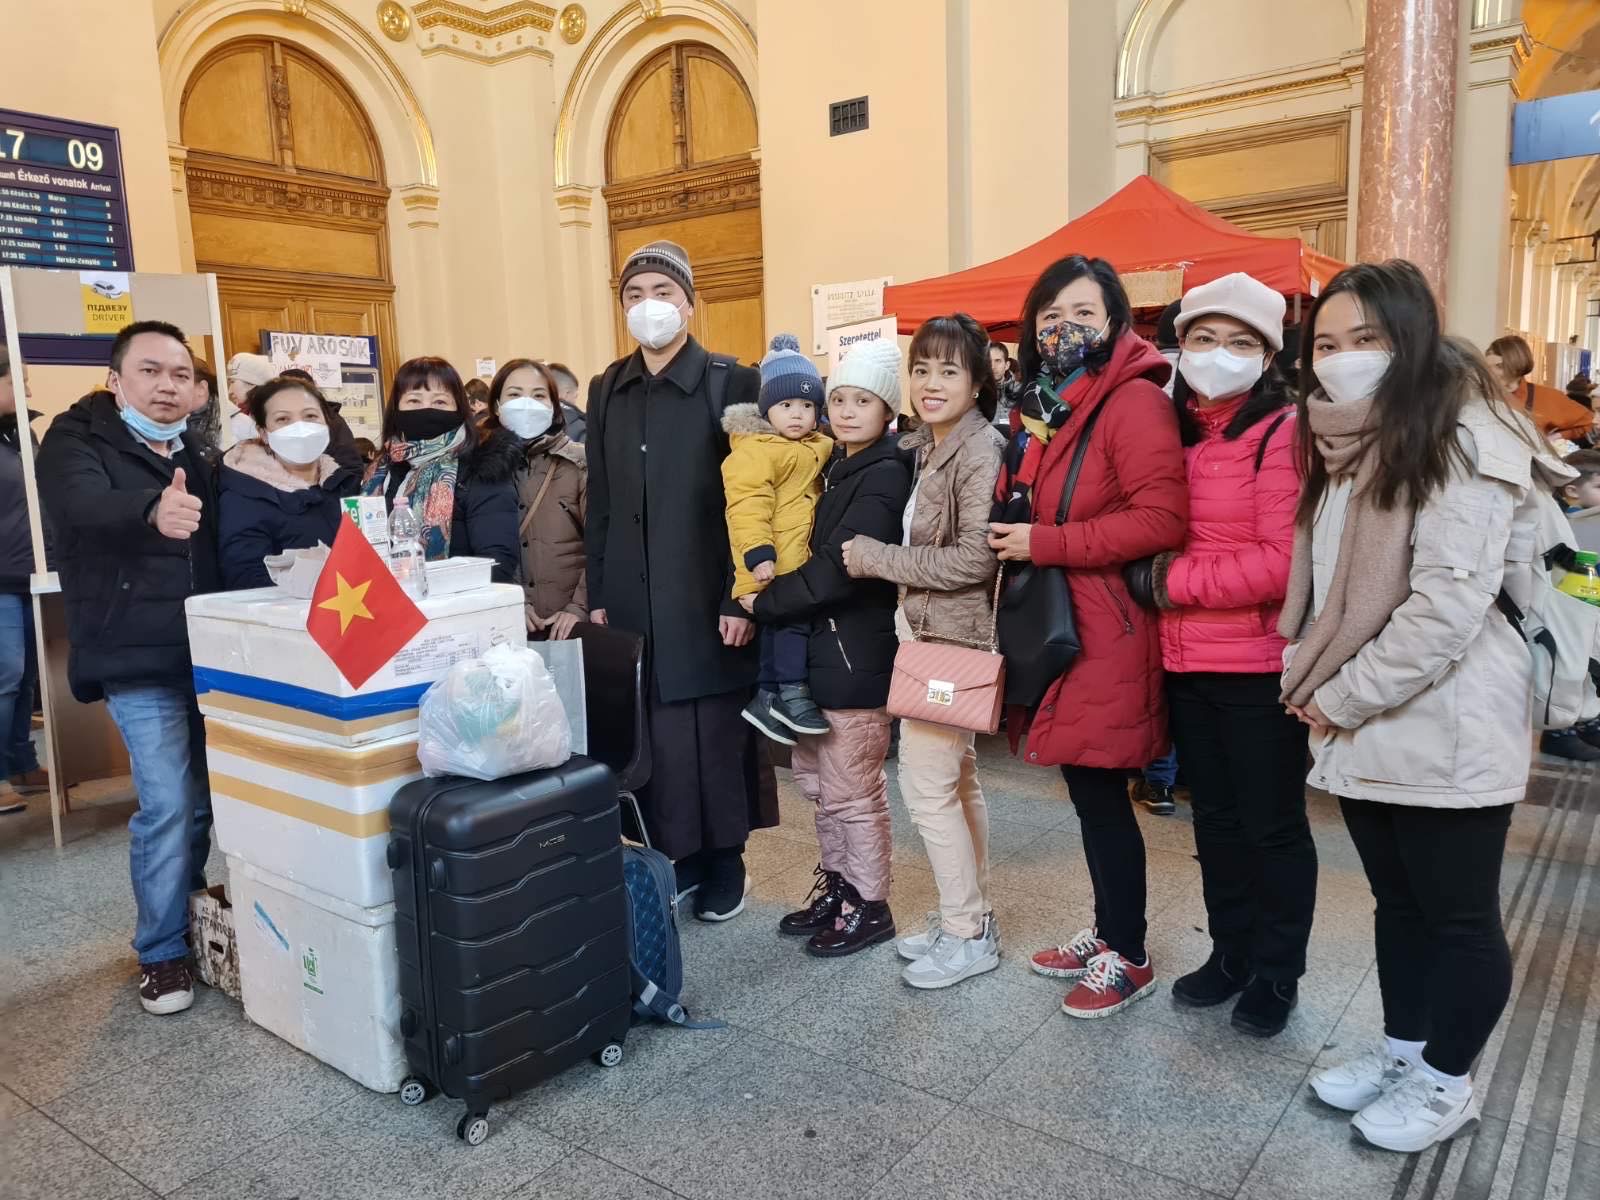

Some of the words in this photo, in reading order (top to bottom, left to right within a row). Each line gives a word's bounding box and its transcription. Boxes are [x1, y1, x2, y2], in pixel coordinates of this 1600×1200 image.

[67, 138, 104, 171] 09
[18, 168, 50, 185] Érkező
[52, 176, 89, 190] vonatok
[87, 303, 128, 312] ПІДВЕЗУ
[92, 313, 126, 322] DRIVER
[839, 328, 881, 347] Szeretettel
